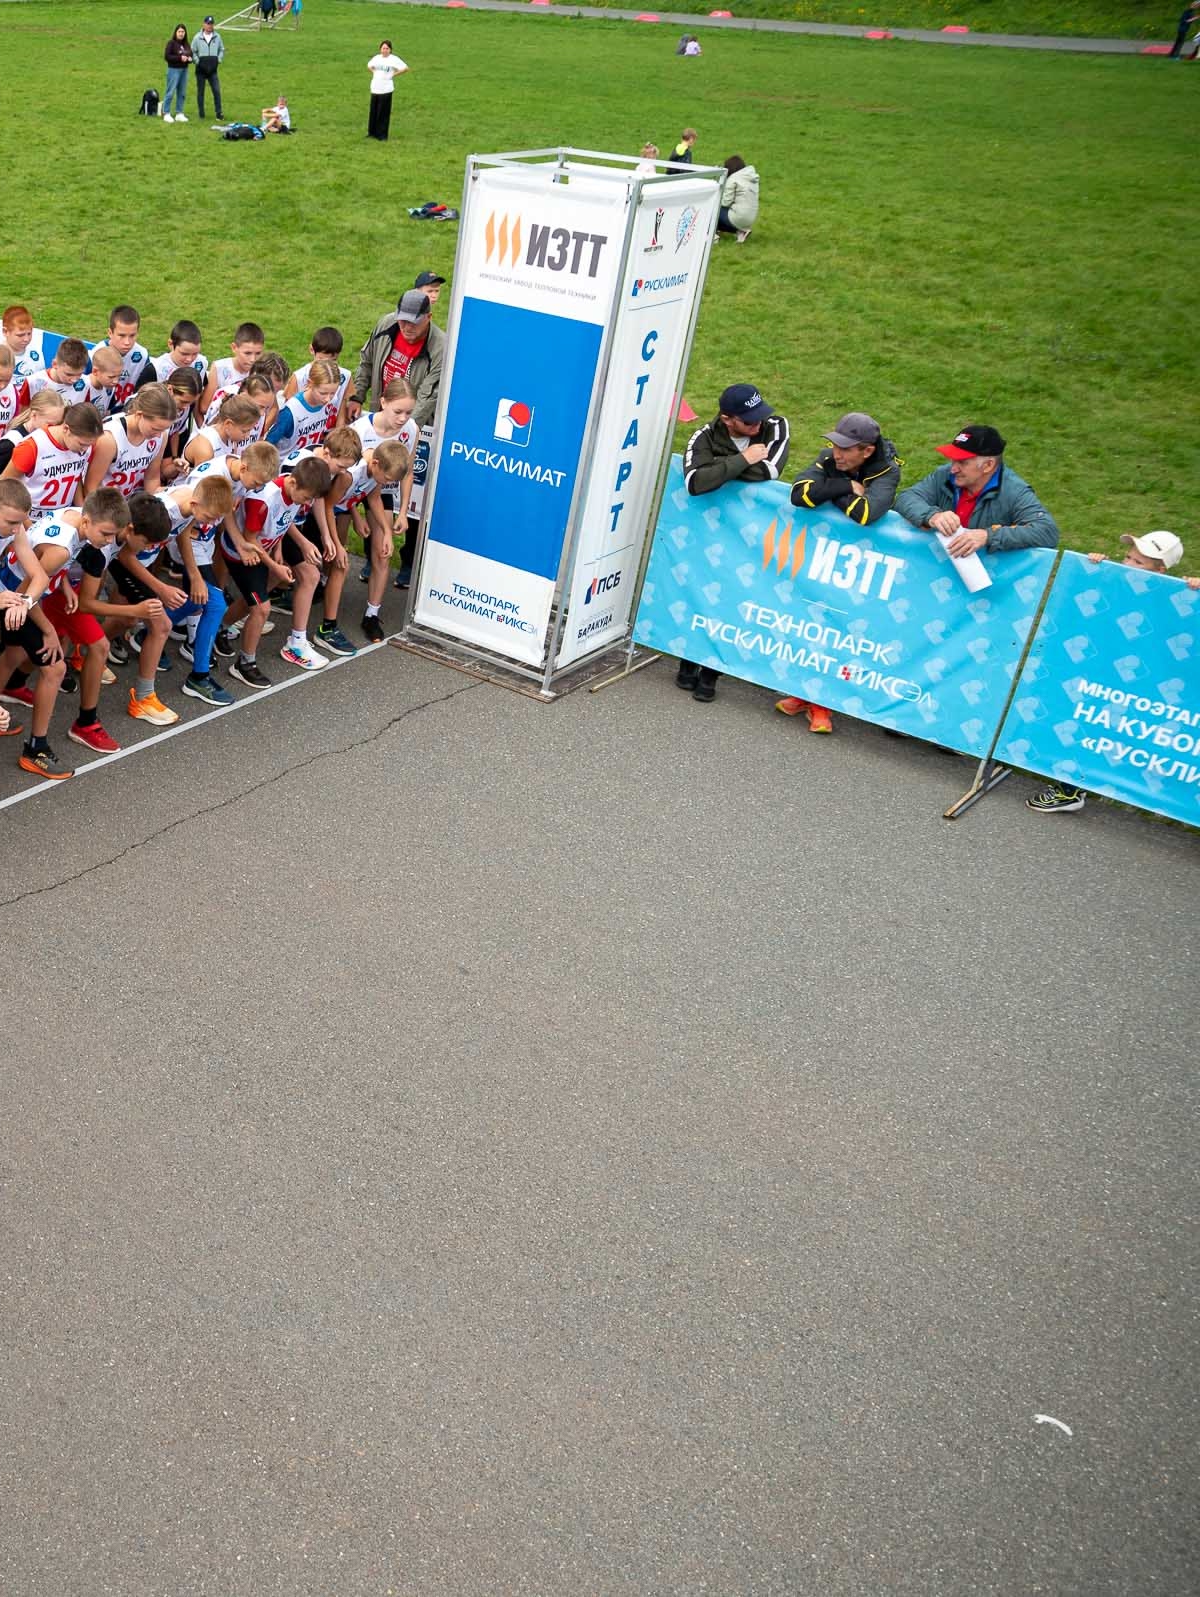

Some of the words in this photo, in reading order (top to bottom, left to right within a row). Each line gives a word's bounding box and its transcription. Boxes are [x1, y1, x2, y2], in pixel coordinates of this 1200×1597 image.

[526, 223, 608, 278] ИЗТТ
[643, 273, 689, 293] РУСКЛИМАТ
[611, 330, 658, 532] СТАРТ
[43, 459, 86, 477] УДМУРТИЯ
[451, 441, 566, 488] РУСКЛИМАТ
[597, 570, 622, 595] ПСБ
[807, 536, 905, 601] ИЗТТ
[429, 589, 497, 621] РУСКЛИМАТ
[452, 582, 520, 616] ТЕХНОПАРК
[691, 614, 837, 674] РУСКЛИМАТ
[741, 601, 895, 666] ТЕХНОПАРК
[1073, 702, 1110, 730] НА
